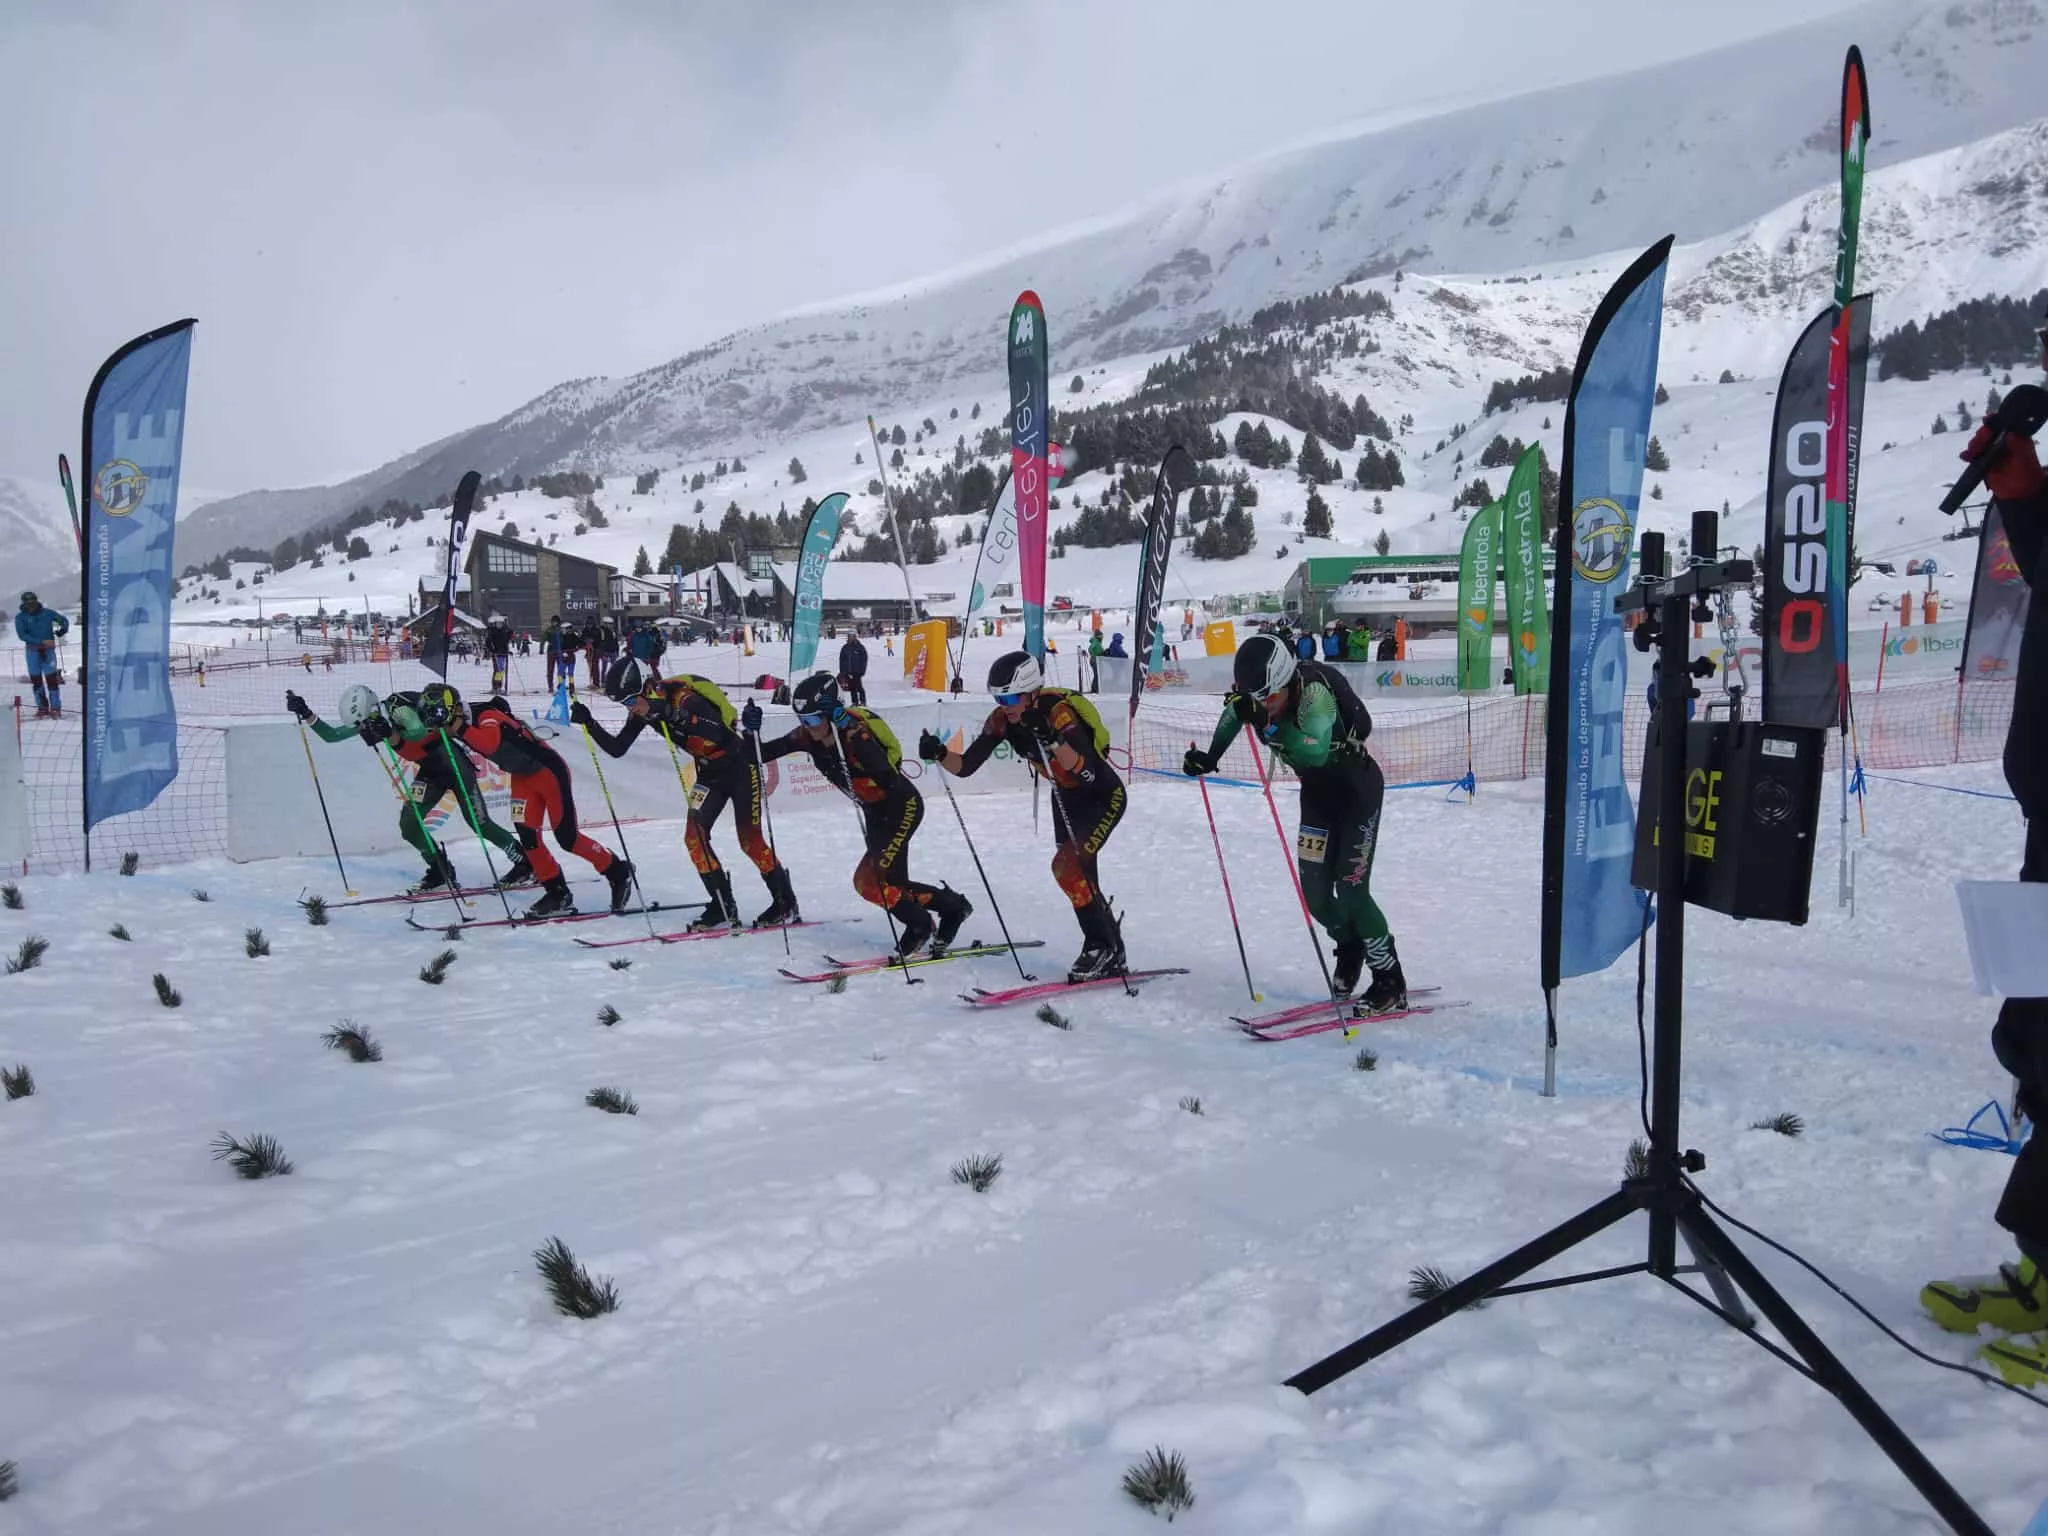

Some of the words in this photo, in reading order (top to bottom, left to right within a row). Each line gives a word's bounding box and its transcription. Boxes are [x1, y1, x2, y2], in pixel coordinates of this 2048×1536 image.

[1016, 381, 1039, 522] cerler
[97, 524, 109, 586] montaña
[986, 502, 1019, 564] cerl
[1470, 524, 1491, 606] Iberdrola
[98, 590, 108, 605] de
[566, 599, 598, 610] cerler
[95, 611, 109, 669] deportes
[94, 675, 106, 693] los
[1406, 673, 1459, 687] Iberdro
[1578, 680, 1589, 745] deportes
[1579, 749, 1589, 769] los
[879, 796, 918, 869] CATALUNYA
[1297, 835, 1326, 851] 217
[1572, 773, 1588, 856] impulsando
